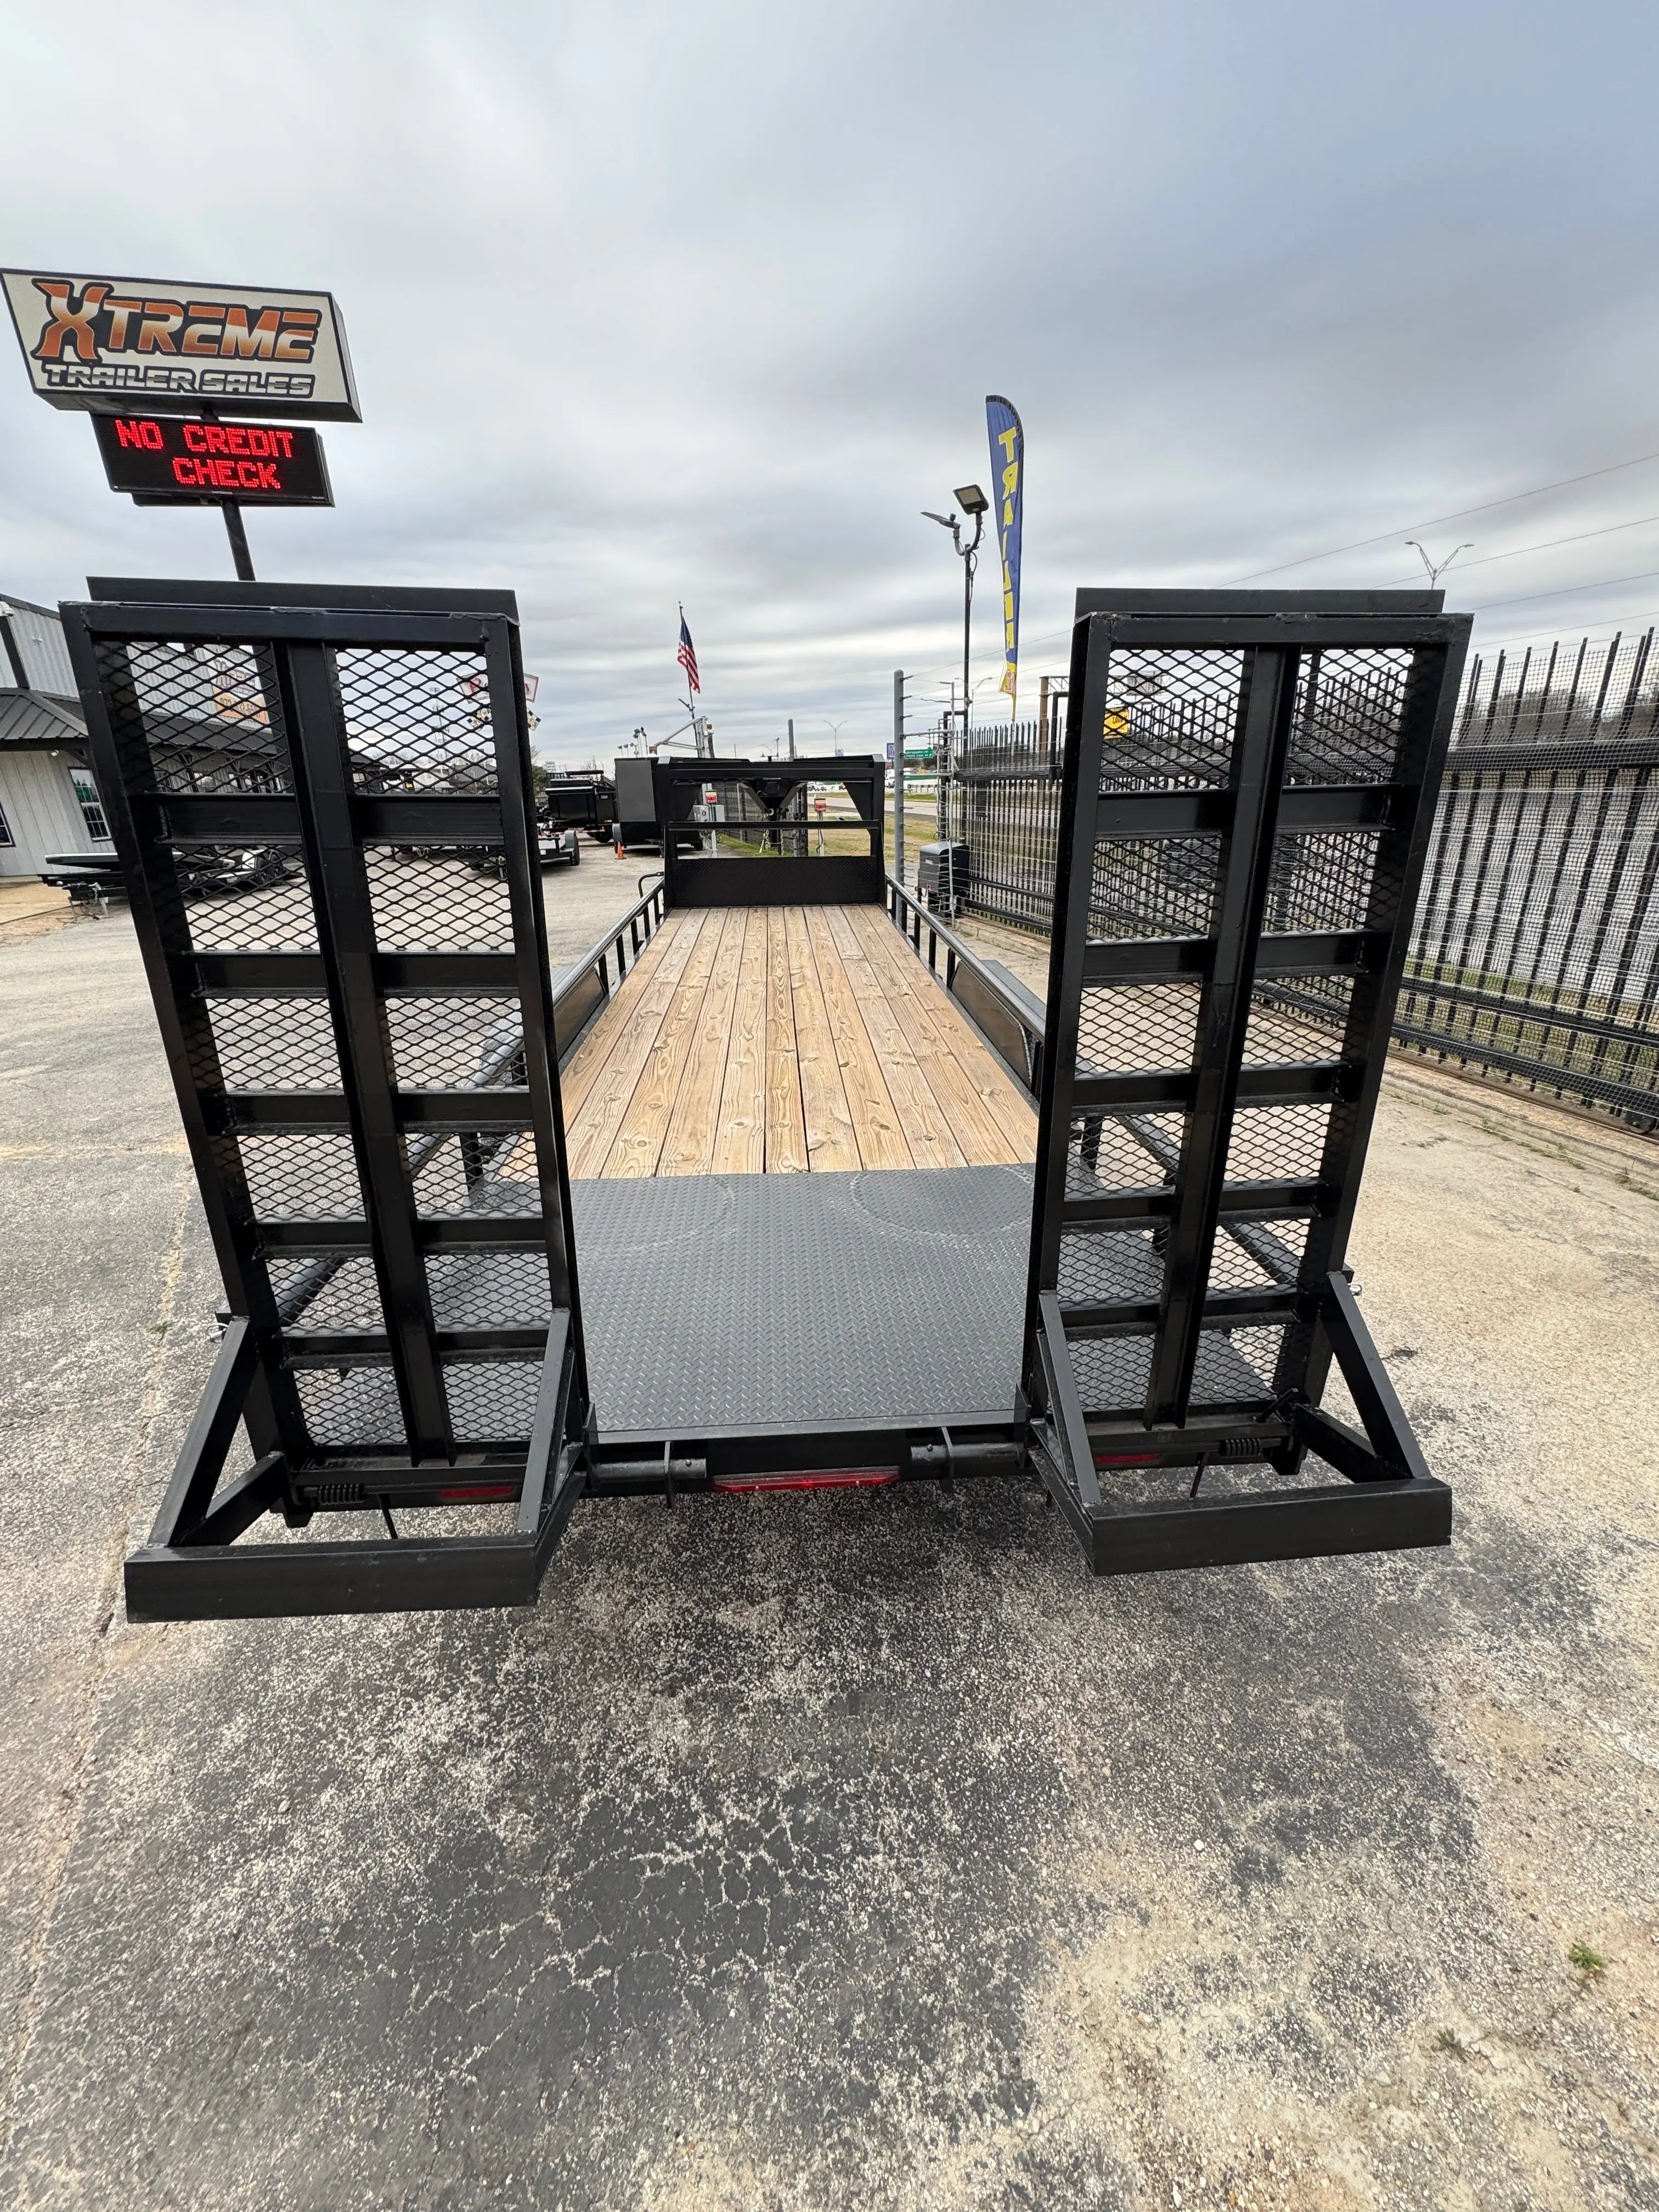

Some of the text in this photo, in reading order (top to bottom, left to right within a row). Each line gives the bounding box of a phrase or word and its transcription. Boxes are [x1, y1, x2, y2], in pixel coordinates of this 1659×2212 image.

[32, 279, 321, 362] XTREME
[43, 363, 314, 396] TRAILER SALES
[115, 419, 293, 458] NO CREDIT
[172, 456, 281, 489] CHECK
